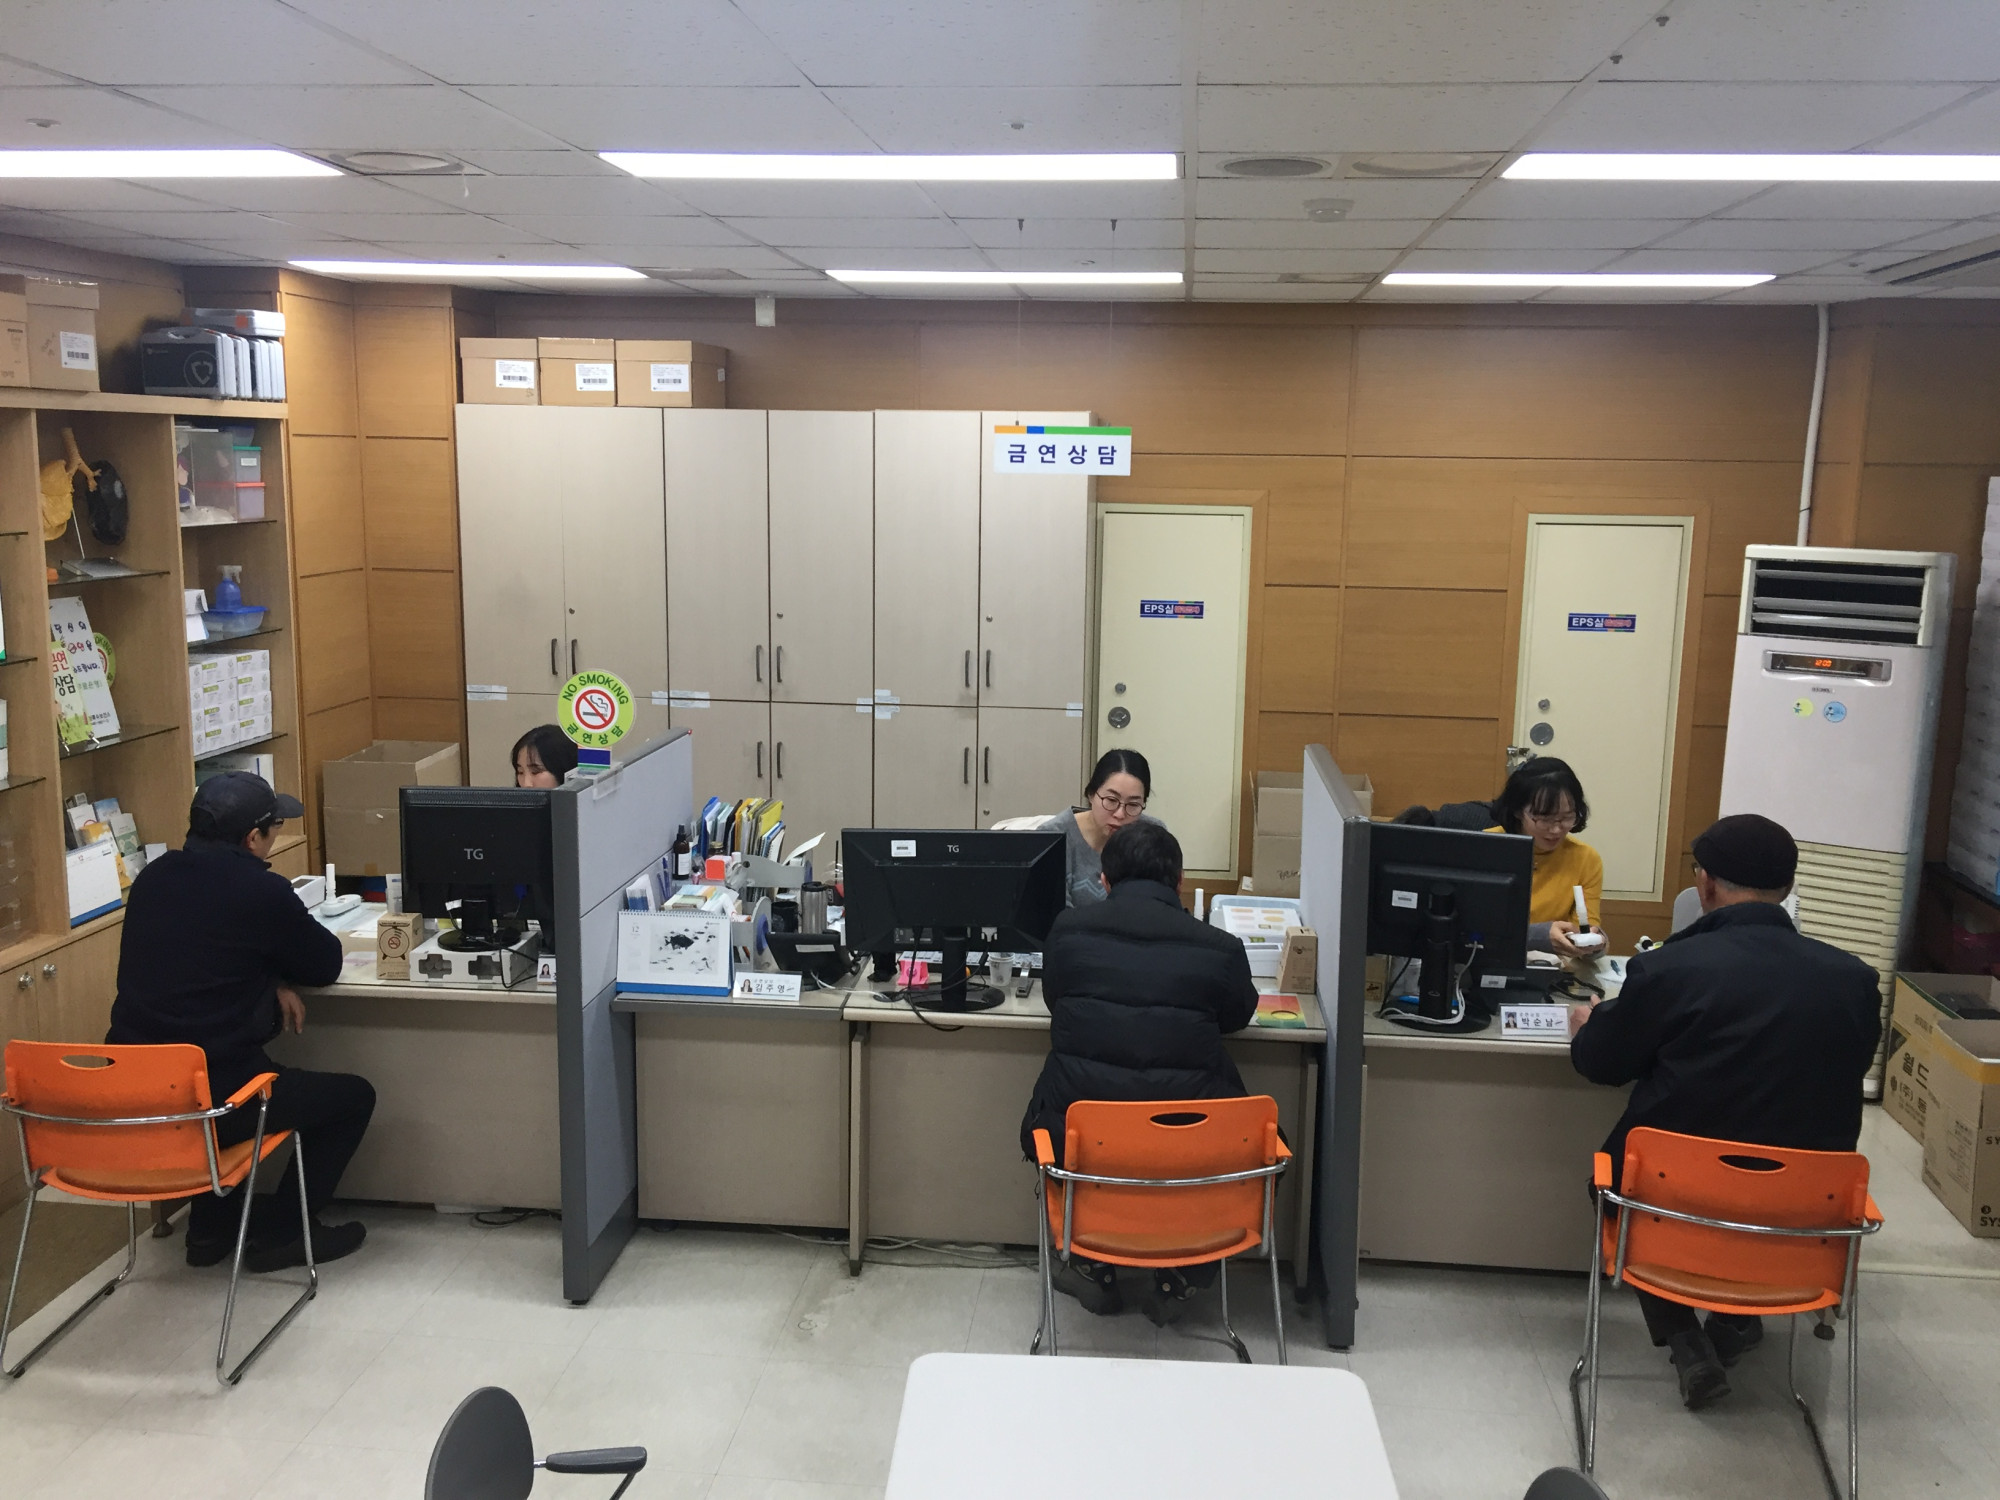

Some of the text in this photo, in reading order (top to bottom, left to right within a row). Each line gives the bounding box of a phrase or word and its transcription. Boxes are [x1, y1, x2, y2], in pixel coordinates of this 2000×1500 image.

[562, 674, 629, 704] NO SMOKING
[463, 848, 484, 860] TG
[947, 844, 960, 853] TG
